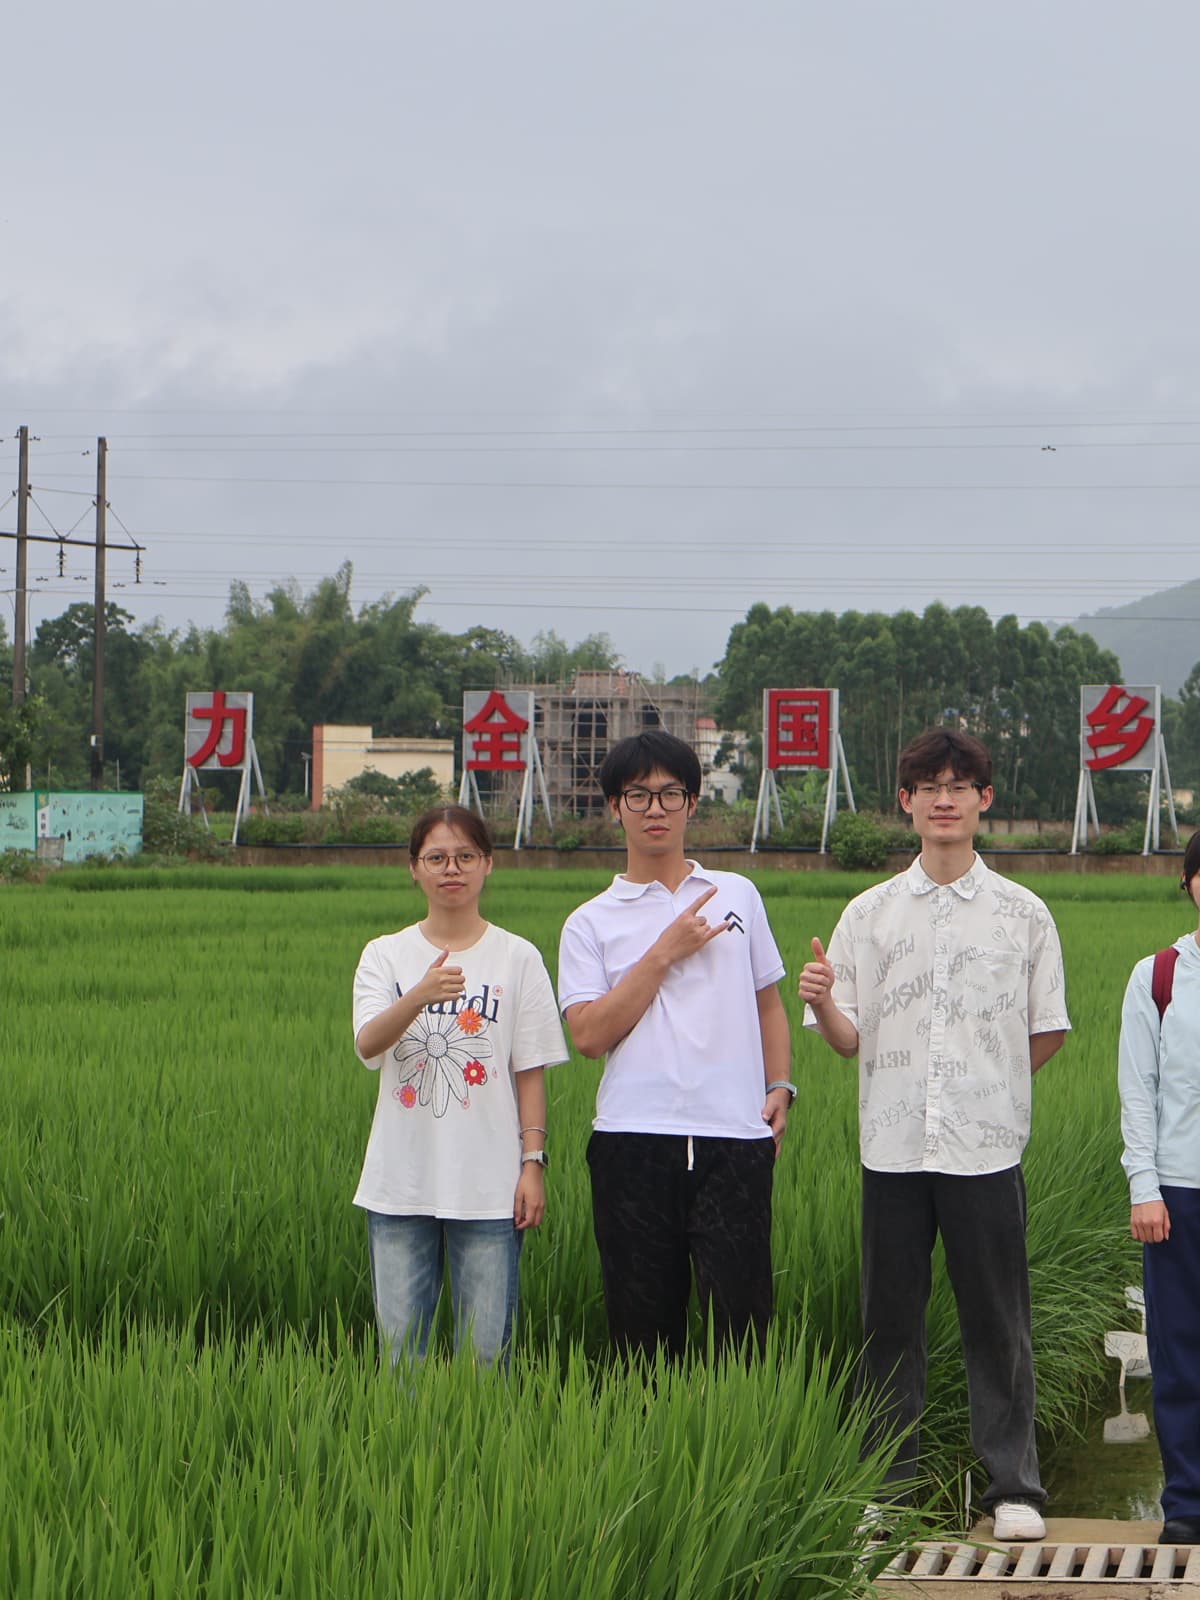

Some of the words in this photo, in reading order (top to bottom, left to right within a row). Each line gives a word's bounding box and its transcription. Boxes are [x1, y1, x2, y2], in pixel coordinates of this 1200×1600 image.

[187, 691, 246, 769] 力
[464, 691, 529, 771] 全
[767, 690, 830, 770] 国
[1086, 684, 1155, 771] 乡
[395, 981, 499, 1023] ardi
